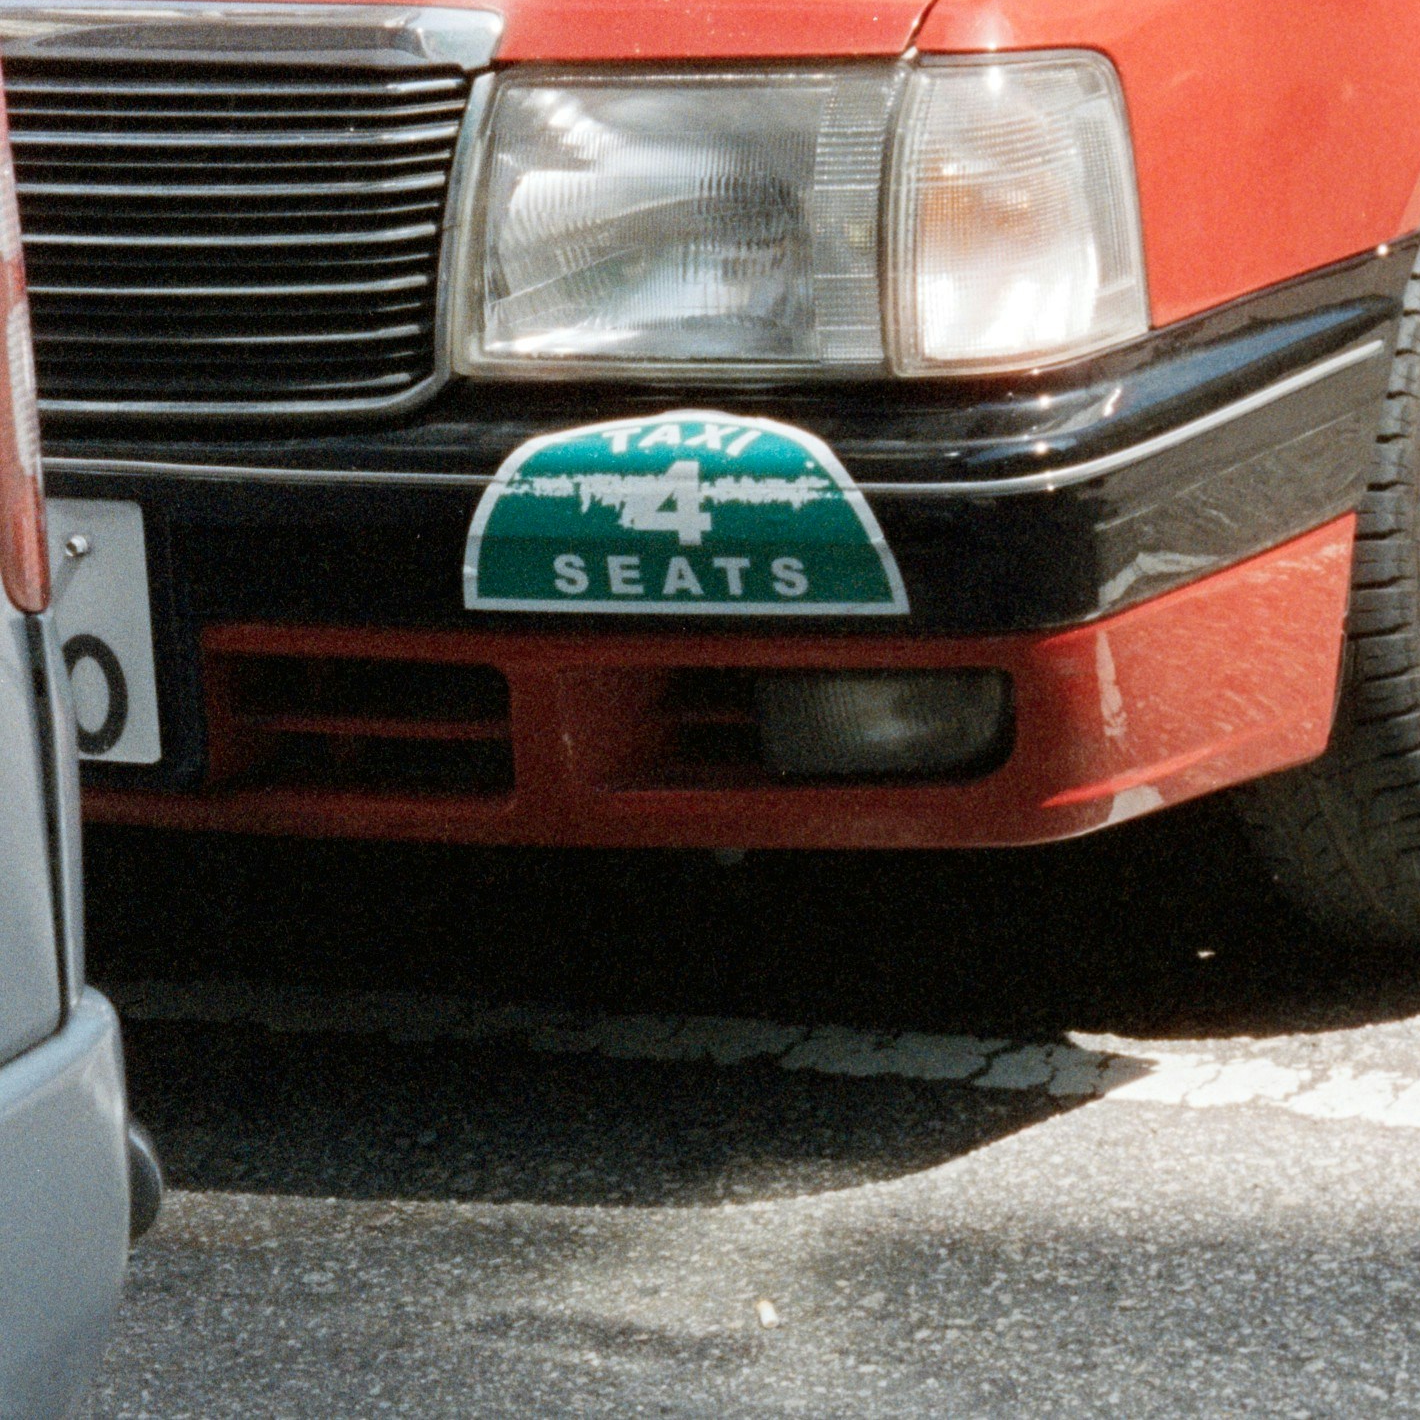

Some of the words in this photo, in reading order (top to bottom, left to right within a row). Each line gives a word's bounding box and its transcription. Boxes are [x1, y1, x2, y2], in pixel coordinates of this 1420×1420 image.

[603, 423, 762, 457] TAXI
[618, 460, 712, 546] 4
[553, 554, 809, 597] SEATS
